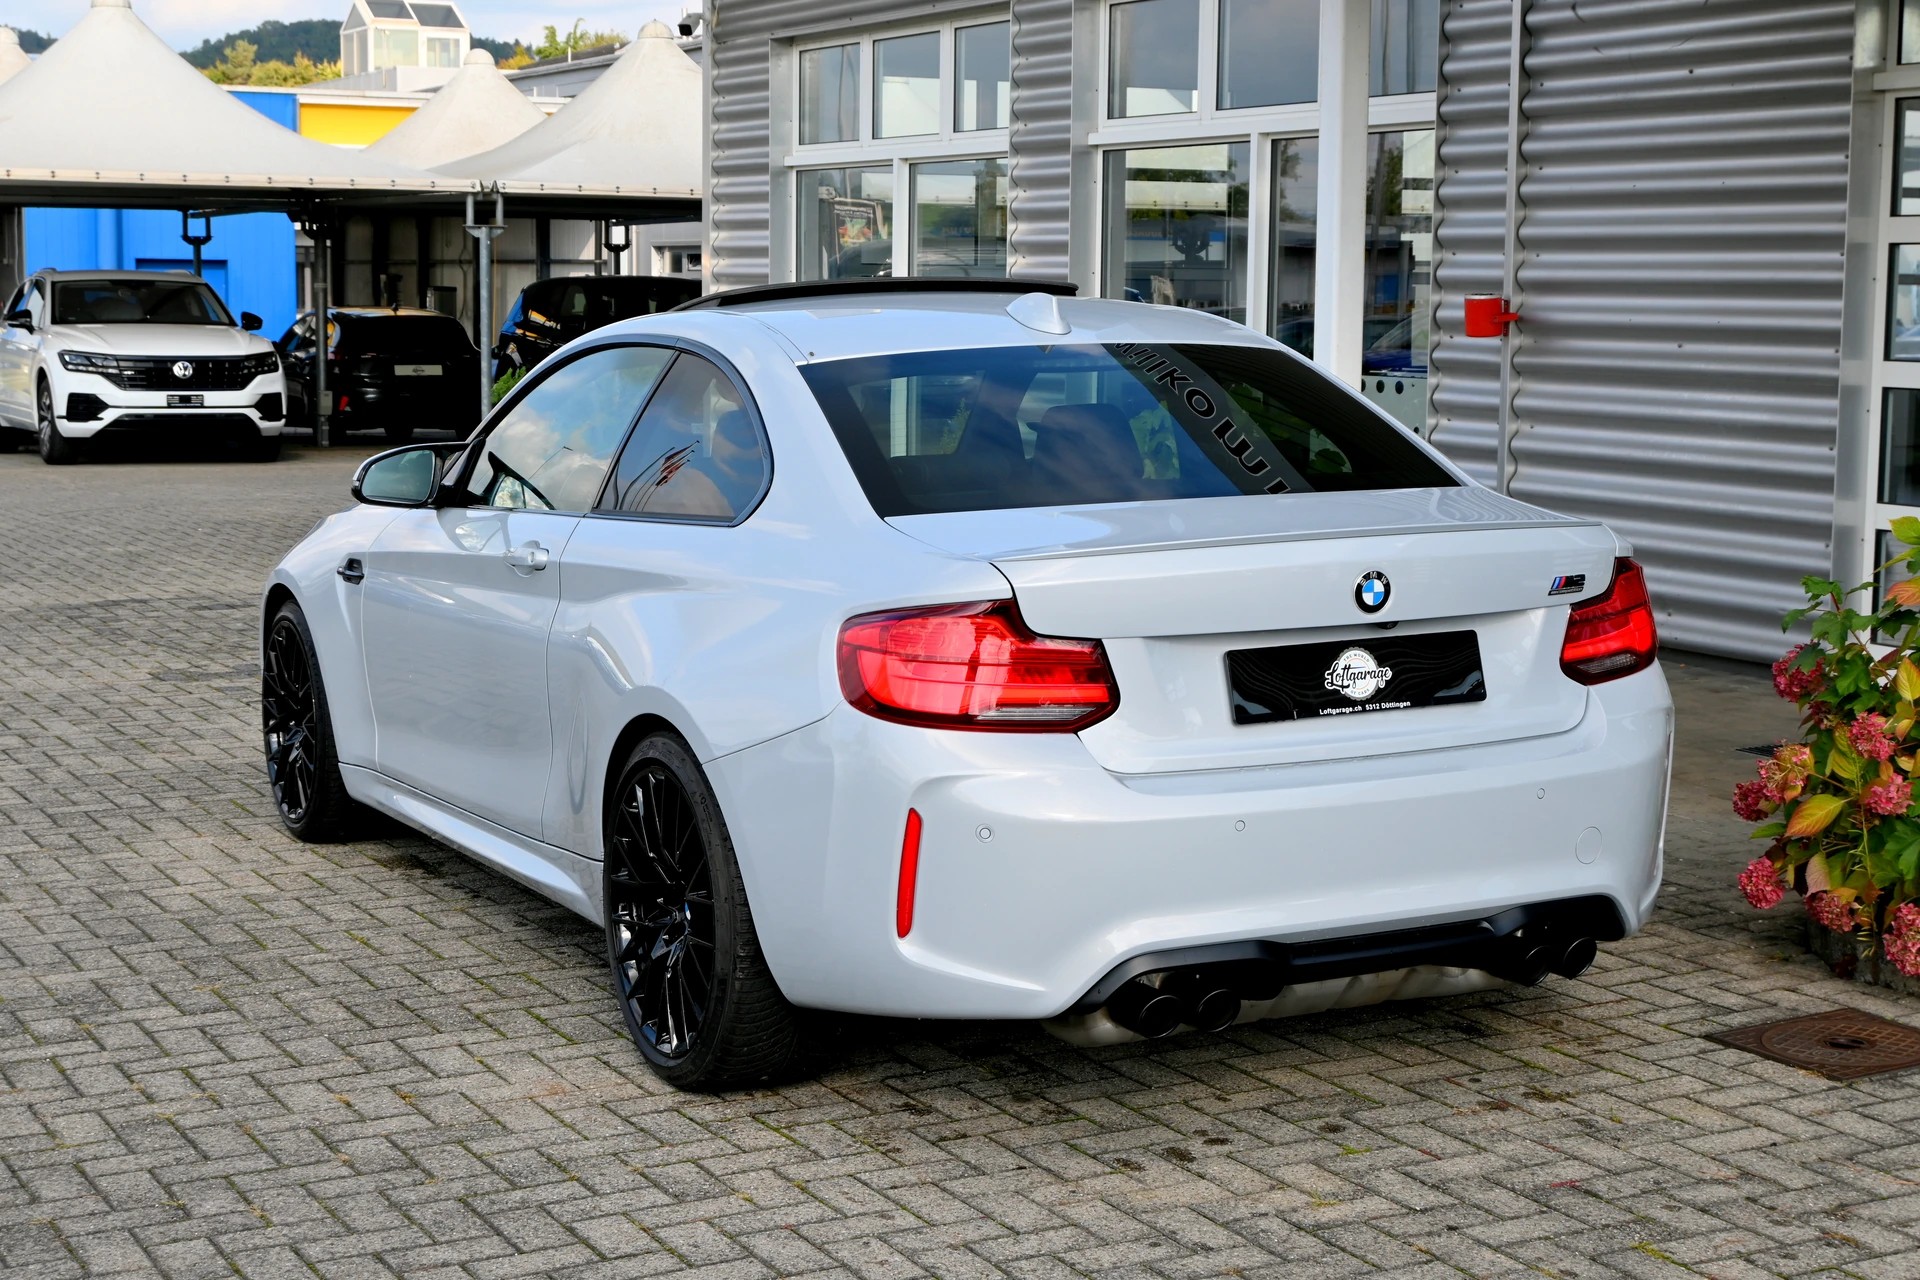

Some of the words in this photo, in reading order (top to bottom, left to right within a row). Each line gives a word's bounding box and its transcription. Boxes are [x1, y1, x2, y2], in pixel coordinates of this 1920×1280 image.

[1325, 661, 1392, 694] Loftgarage
[1319, 705, 1362, 715] Loftgarage.ch
[1365, 703, 1380, 711] 5312
[1381, 701, 1411, 709] Döttingen
